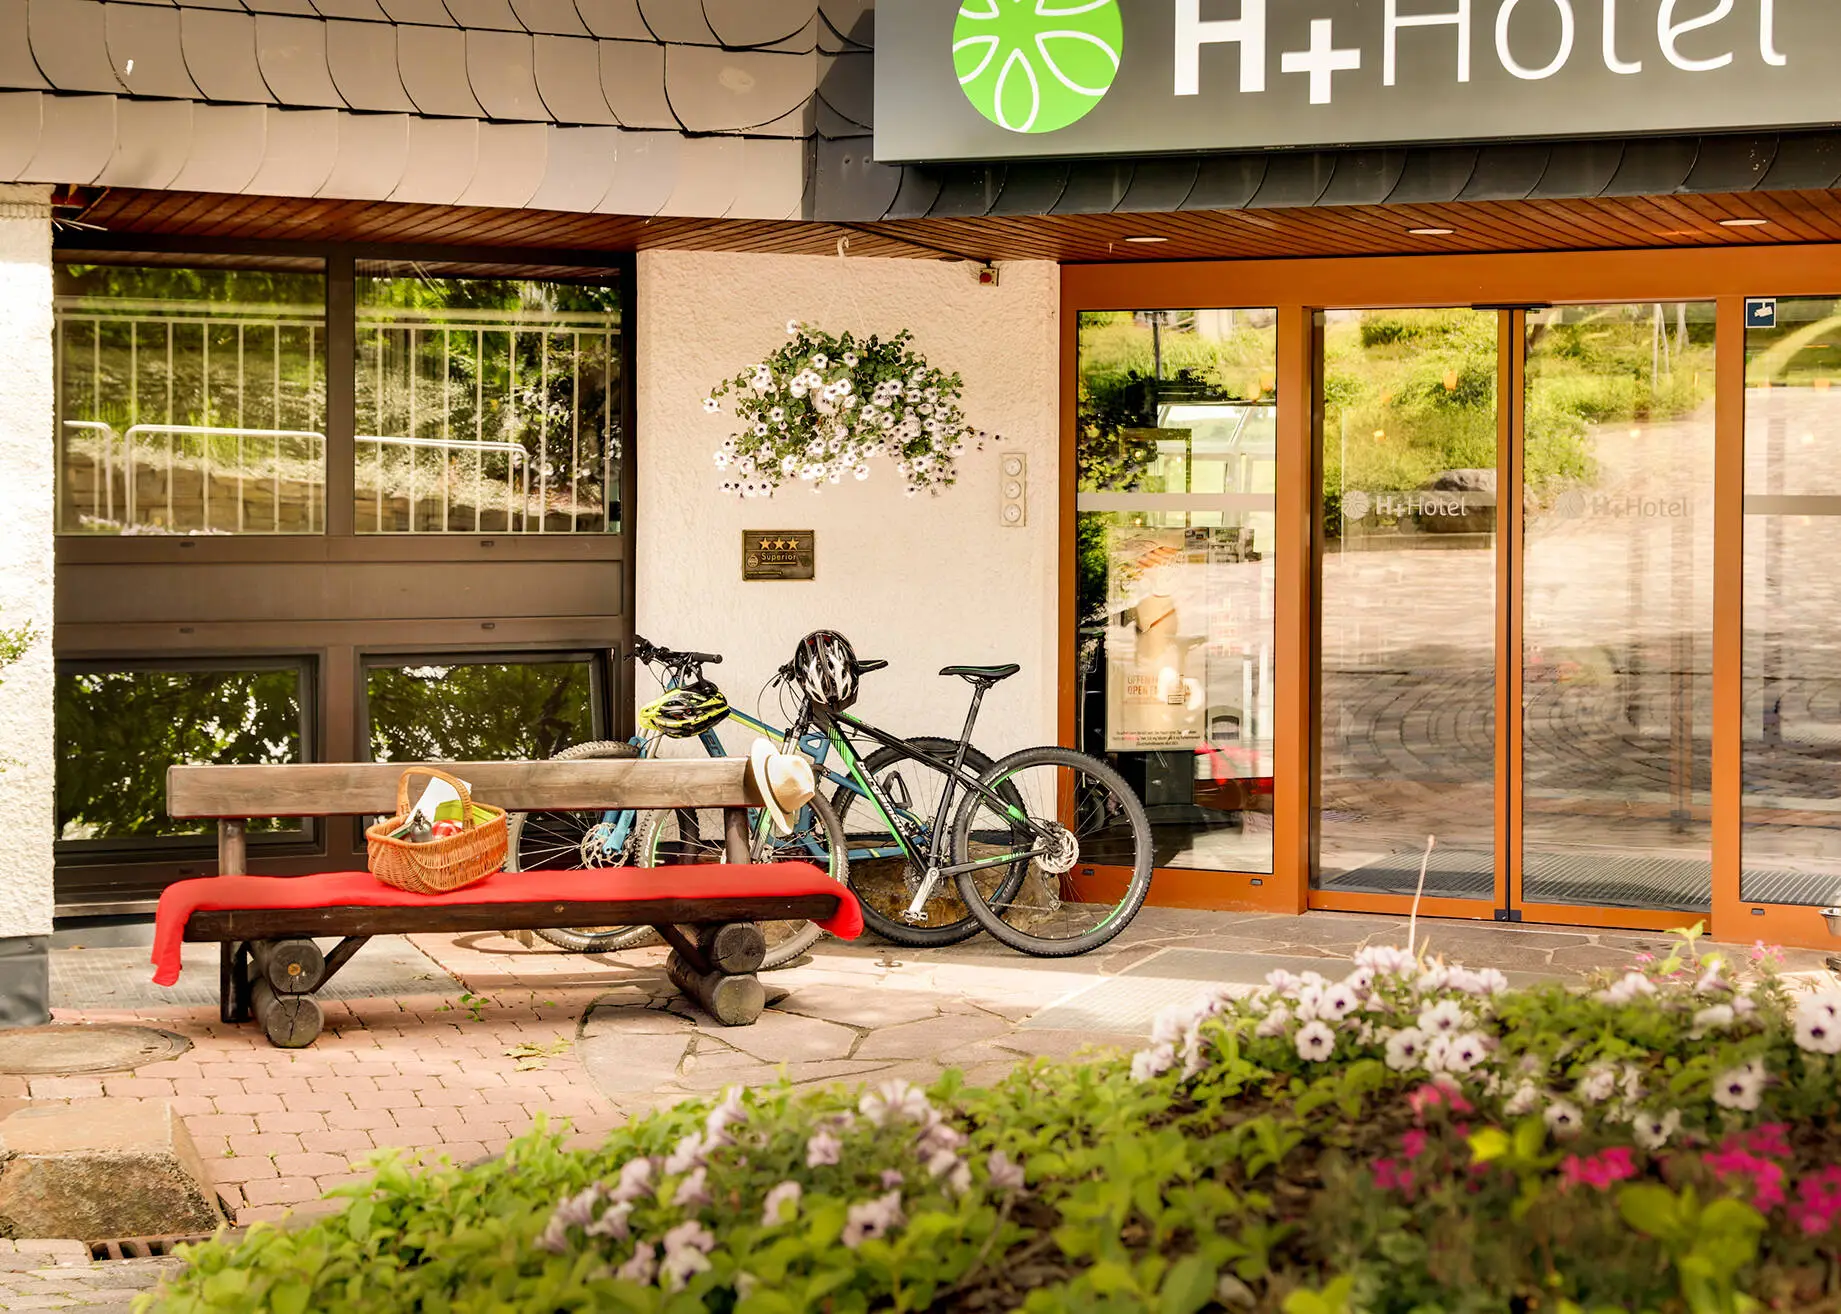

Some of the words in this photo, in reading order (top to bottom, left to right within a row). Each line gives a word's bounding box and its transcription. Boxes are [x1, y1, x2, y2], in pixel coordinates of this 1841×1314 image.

[1175, 0, 1787, 104] H+Hotel
[1375, 495, 1468, 517] H+Hotel
[761, 552, 797, 562] Superior
[856, 761, 910, 836] bergamont
